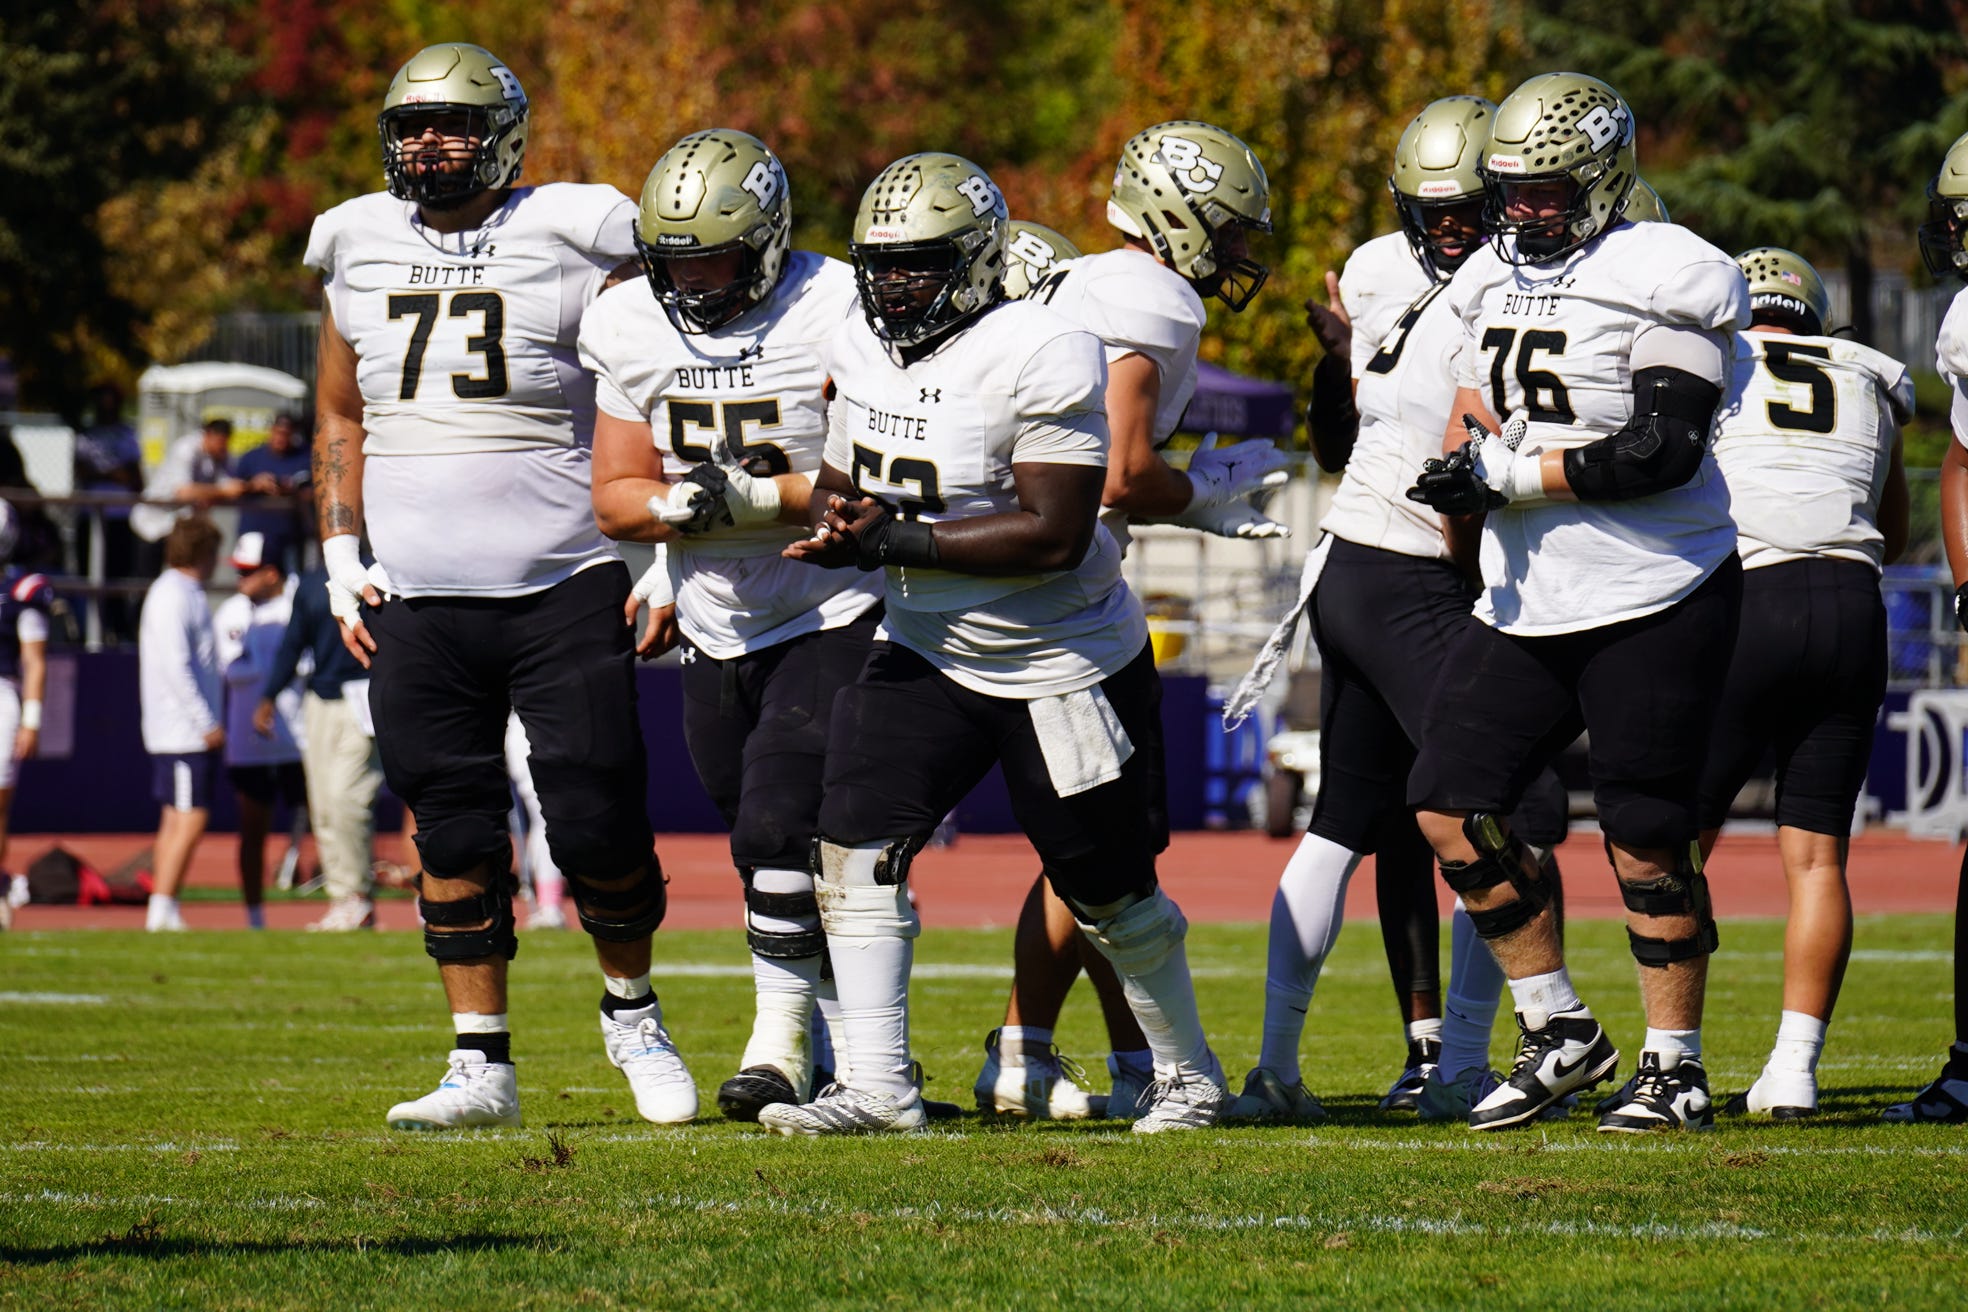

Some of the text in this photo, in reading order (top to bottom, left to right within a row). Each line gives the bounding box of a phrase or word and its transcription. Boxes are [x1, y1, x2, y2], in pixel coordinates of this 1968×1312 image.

[488, 65, 528, 105] B
[1155, 135, 1225, 194] BC
[408, 264, 485, 285] BUTTE
[1502, 293, 1561, 317] BUTTE
[1751, 293, 1806, 316] iddell
[386, 290, 509, 401] 73
[676, 364, 755, 390] BUTTE
[1480, 325, 1577, 426] 76
[1761, 340, 1837, 434] 5
[868, 407, 928, 441] BUTTE
